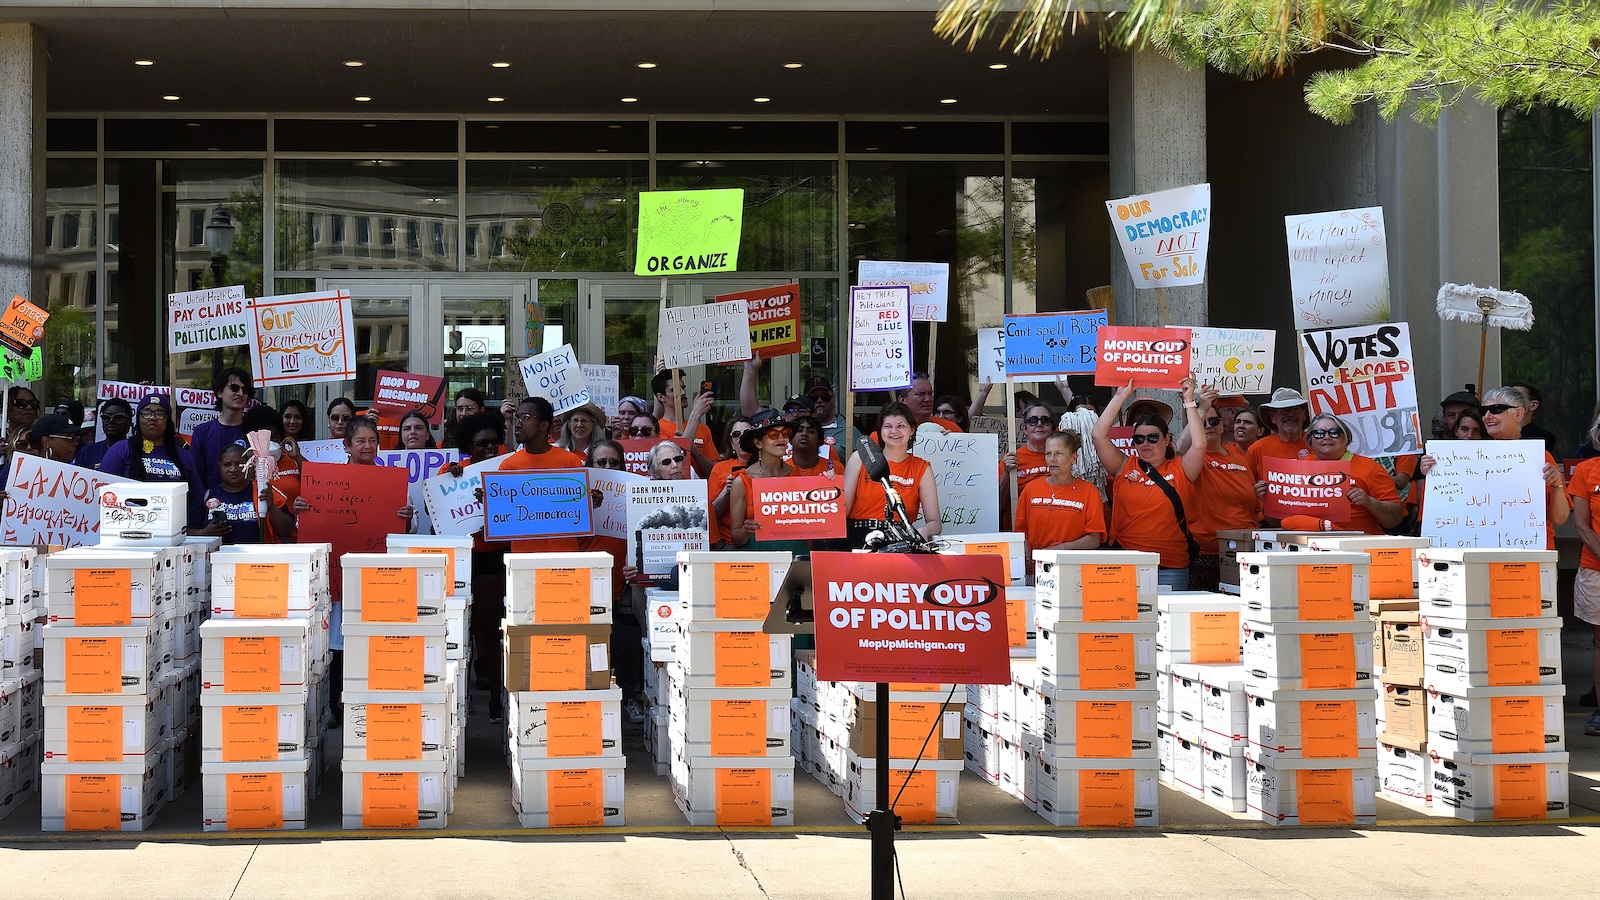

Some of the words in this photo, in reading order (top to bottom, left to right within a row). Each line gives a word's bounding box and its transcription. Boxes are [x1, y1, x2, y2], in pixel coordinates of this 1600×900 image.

[1116, 200, 1152, 220] OUR
[1125, 208, 1207, 242] DEMOCRACY
[1291, 220, 1314, 240] The
[1319, 221, 1360, 250] Many
[502, 239, 550, 247] RICHARD
[1134, 246, 1144, 255] is
[1157, 232, 1200, 254] NOT
[647, 253, 728, 272] ORGANIZE
[1325, 248, 1367, 268] defeat
[1140, 262, 1168, 280] For
[1310, 270, 1338, 284] the
[747, 298, 766, 310] NEY
[768, 295, 790, 307] OUT
[857, 291, 871, 300] HEY
[1309, 289, 1352, 310] Money
[174, 308, 194, 323] PAY
[198, 301, 242, 319] CLAIMS
[261, 307, 295, 331] Our
[666, 310, 686, 324] ALL
[692, 302, 744, 320] POLITICAL
[879, 311, 900, 319] RED
[12, 316, 31, 333] NOT
[855, 317, 870, 328] Both
[877, 322, 902, 331] BLUE
[1036, 320, 1065, 343] spell
[1071, 317, 1108, 335] BCBS
[175, 323, 247, 347] POLITICIANS
[262, 328, 336, 351] Democracy
[761, 325, 792, 342] HERE
[1207, 329, 1264, 341] CONSUMING
[689, 334, 737, 349] inherent
[866, 337, 886, 346] about
[889, 339, 903, 347] you
[1104, 340, 1152, 351] MONEY
[1154, 341, 1183, 352] OUT
[1304, 326, 1401, 372] VOTES
[266, 353, 273, 369] is
[281, 352, 300, 370] NOT
[669, 355, 678, 366] IN
[683, 350, 706, 364] THE
[709, 346, 747, 361] PEOPLE
[854, 349, 868, 357] work
[871, 349, 881, 357] for
[885, 348, 902, 359] US
[1007, 350, 1046, 366] without
[1051, 350, 1076, 364] their
[1103, 353, 1121, 362] OF
[1123, 353, 1183, 365] POLITICS
[523, 351, 570, 378] MONEY
[876, 361, 882, 369] of
[896, 361, 905, 369] the
[1116, 366, 1168, 374] MopUpMichigan.org
[1206, 366, 1221, 376] my
[380, 376, 404, 389] MOP
[406, 379, 420, 390] UP
[540, 369, 567, 388] OUT
[1213, 375, 1264, 391] MONEY
[1311, 375, 1334, 386] are
[378, 389, 429, 404] MICHIGAN!
[550, 384, 565, 398] OF
[1309, 374, 1404, 416] NOT
[551, 389, 589, 413] LITICS
[972, 417, 989, 429] THE
[1111, 438, 1134, 447] NEY
[943, 459, 964, 468] THE
[1430, 452, 1452, 466] They
[1453, 451, 1471, 460] have
[1477, 448, 1489, 460] the
[1496, 453, 1525, 463] money
[13, 457, 48, 499] LA
[303, 476, 321, 486] The
[1268, 471, 1310, 485] MONEY
[1313, 475, 1343, 486] OUT
[1444, 468, 1460, 476] have
[1486, 467, 1512, 481] power
[439, 476, 481, 496] WOR
[489, 482, 518, 503] Stop
[521, 481, 582, 503] Consuming
[632, 486, 649, 494] DARK
[651, 486, 674, 494] MONEY
[1268, 484, 1281, 494] OF
[1283, 486, 1342, 498] POLITICS
[150, 496, 168, 504] 500
[340, 494, 372, 505] defeat
[632, 496, 664, 504] POLLUTES
[666, 496, 698, 504] POLITICS.
[760, 492, 808, 502] MONEY
[810, 490, 838, 501] OUT
[948, 493, 966, 501] THE
[1278, 499, 1329, 508] MopUpMichigan.org
[5, 497, 89, 534] DEMOCRAZIA
[326, 509, 358, 524] money
[450, 501, 482, 519] NOT
[493, 512, 511, 523] our
[516, 506, 581, 524] Democracy
[761, 505, 778, 515] OF
[781, 503, 838, 514] POLITICS
[941, 506, 981, 526] $$$
[602, 516, 627, 532] dine
[775, 516, 826, 525] MopUpMichigan.org
[648, 533, 665, 541] YOUR
[667, 533, 702, 541] SIGNATURE
[1458, 533, 1478, 548] ont
[1498, 532, 1539, 549] l'argent
[828, 582, 929, 604] MONEY
[933, 584, 990, 605] OUT
[829, 607, 866, 629] OF
[871, 609, 992, 632] POLITICS
[859, 639, 965, 653] MopUpMichigan.org
